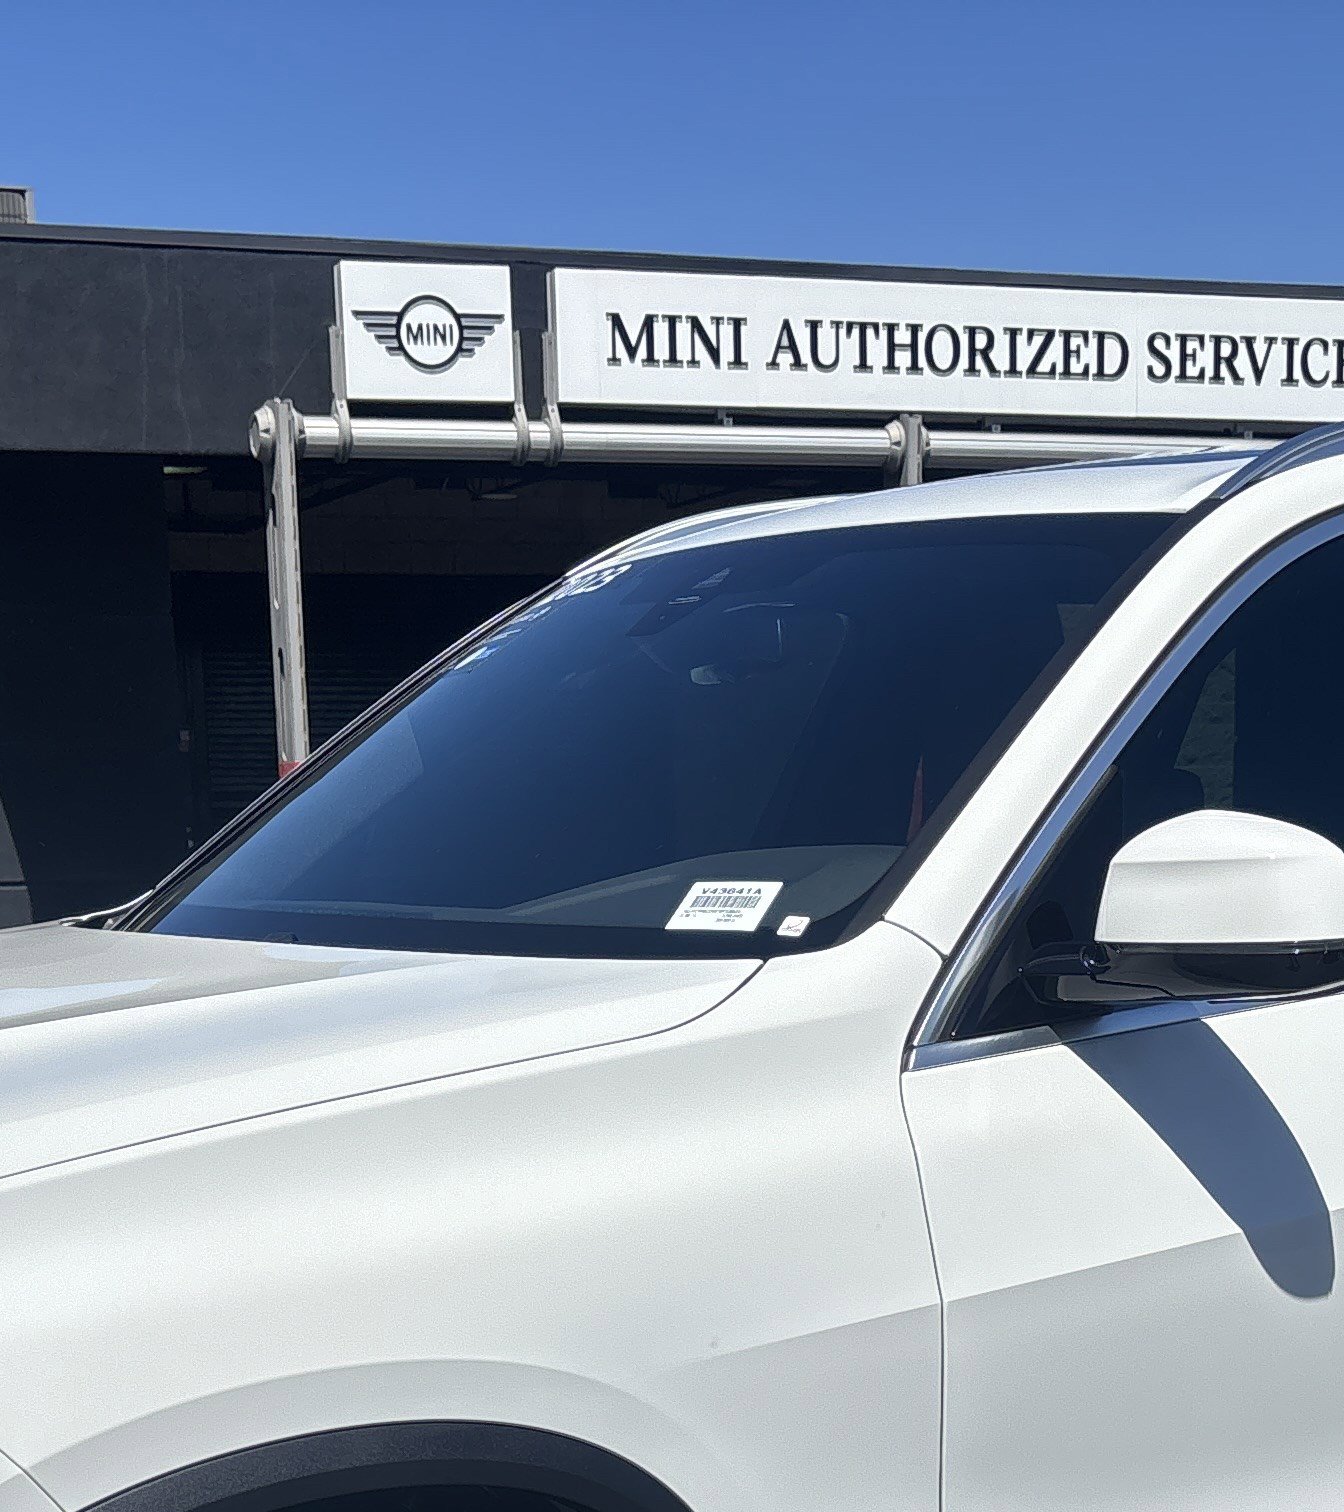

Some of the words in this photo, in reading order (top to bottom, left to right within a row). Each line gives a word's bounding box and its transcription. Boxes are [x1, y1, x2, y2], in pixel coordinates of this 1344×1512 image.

[405, 322, 454, 347] MINI
[605, 311, 749, 371] MINI
[765, 318, 1130, 383] AUTHORIZED
